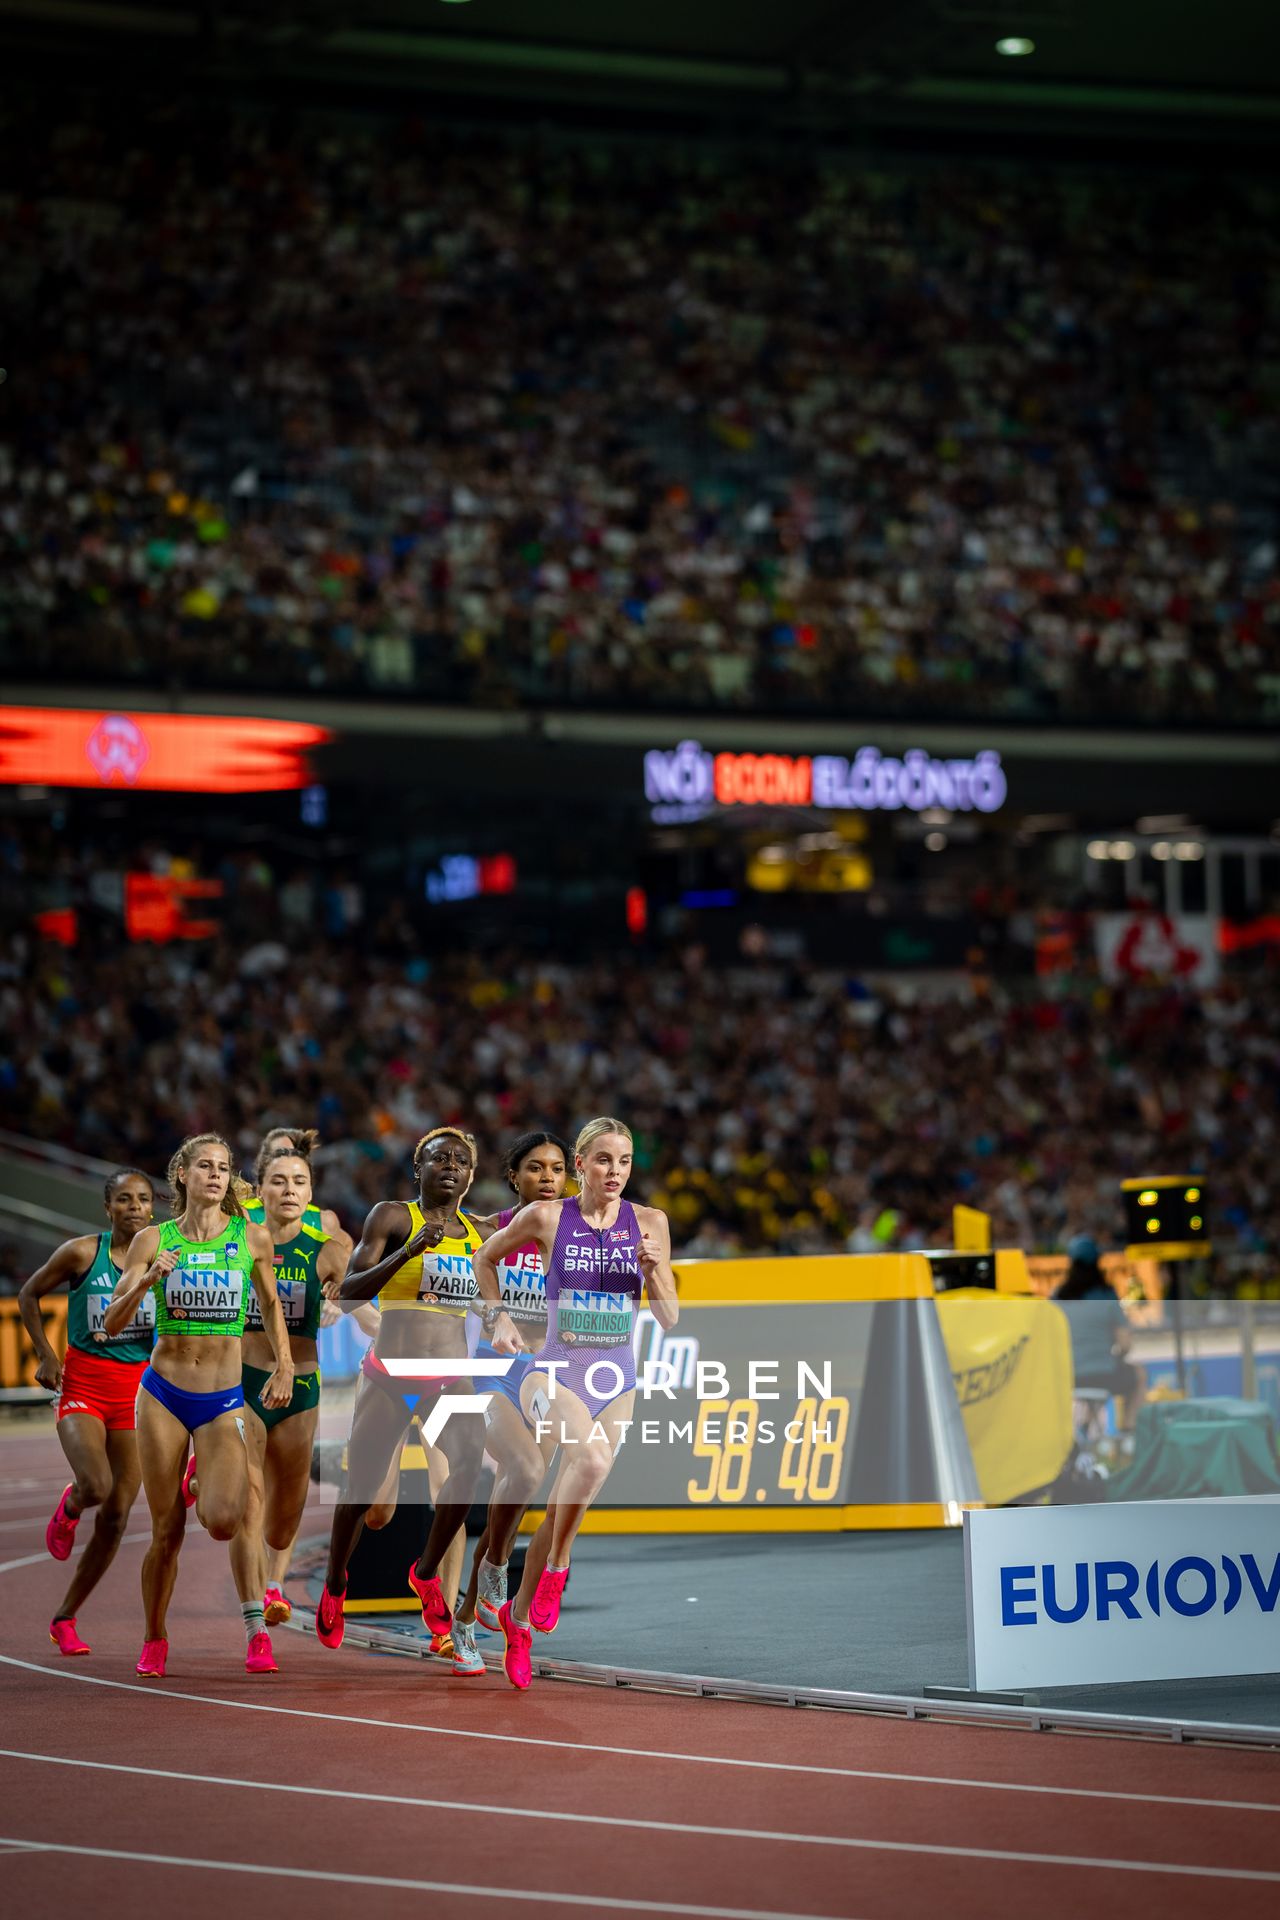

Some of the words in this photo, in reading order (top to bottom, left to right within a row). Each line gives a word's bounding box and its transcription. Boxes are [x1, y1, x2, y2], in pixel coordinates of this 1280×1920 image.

[565, 1244, 635, 1260] GREAT
[564, 1258, 638, 1274] BRITAIN
[181, 1270, 229, 1288] NTN
[170, 1290, 238, 1307] HORVAT
[572, 1290, 625, 1312] NTN
[559, 1311, 630, 1332] HODGKINSON
